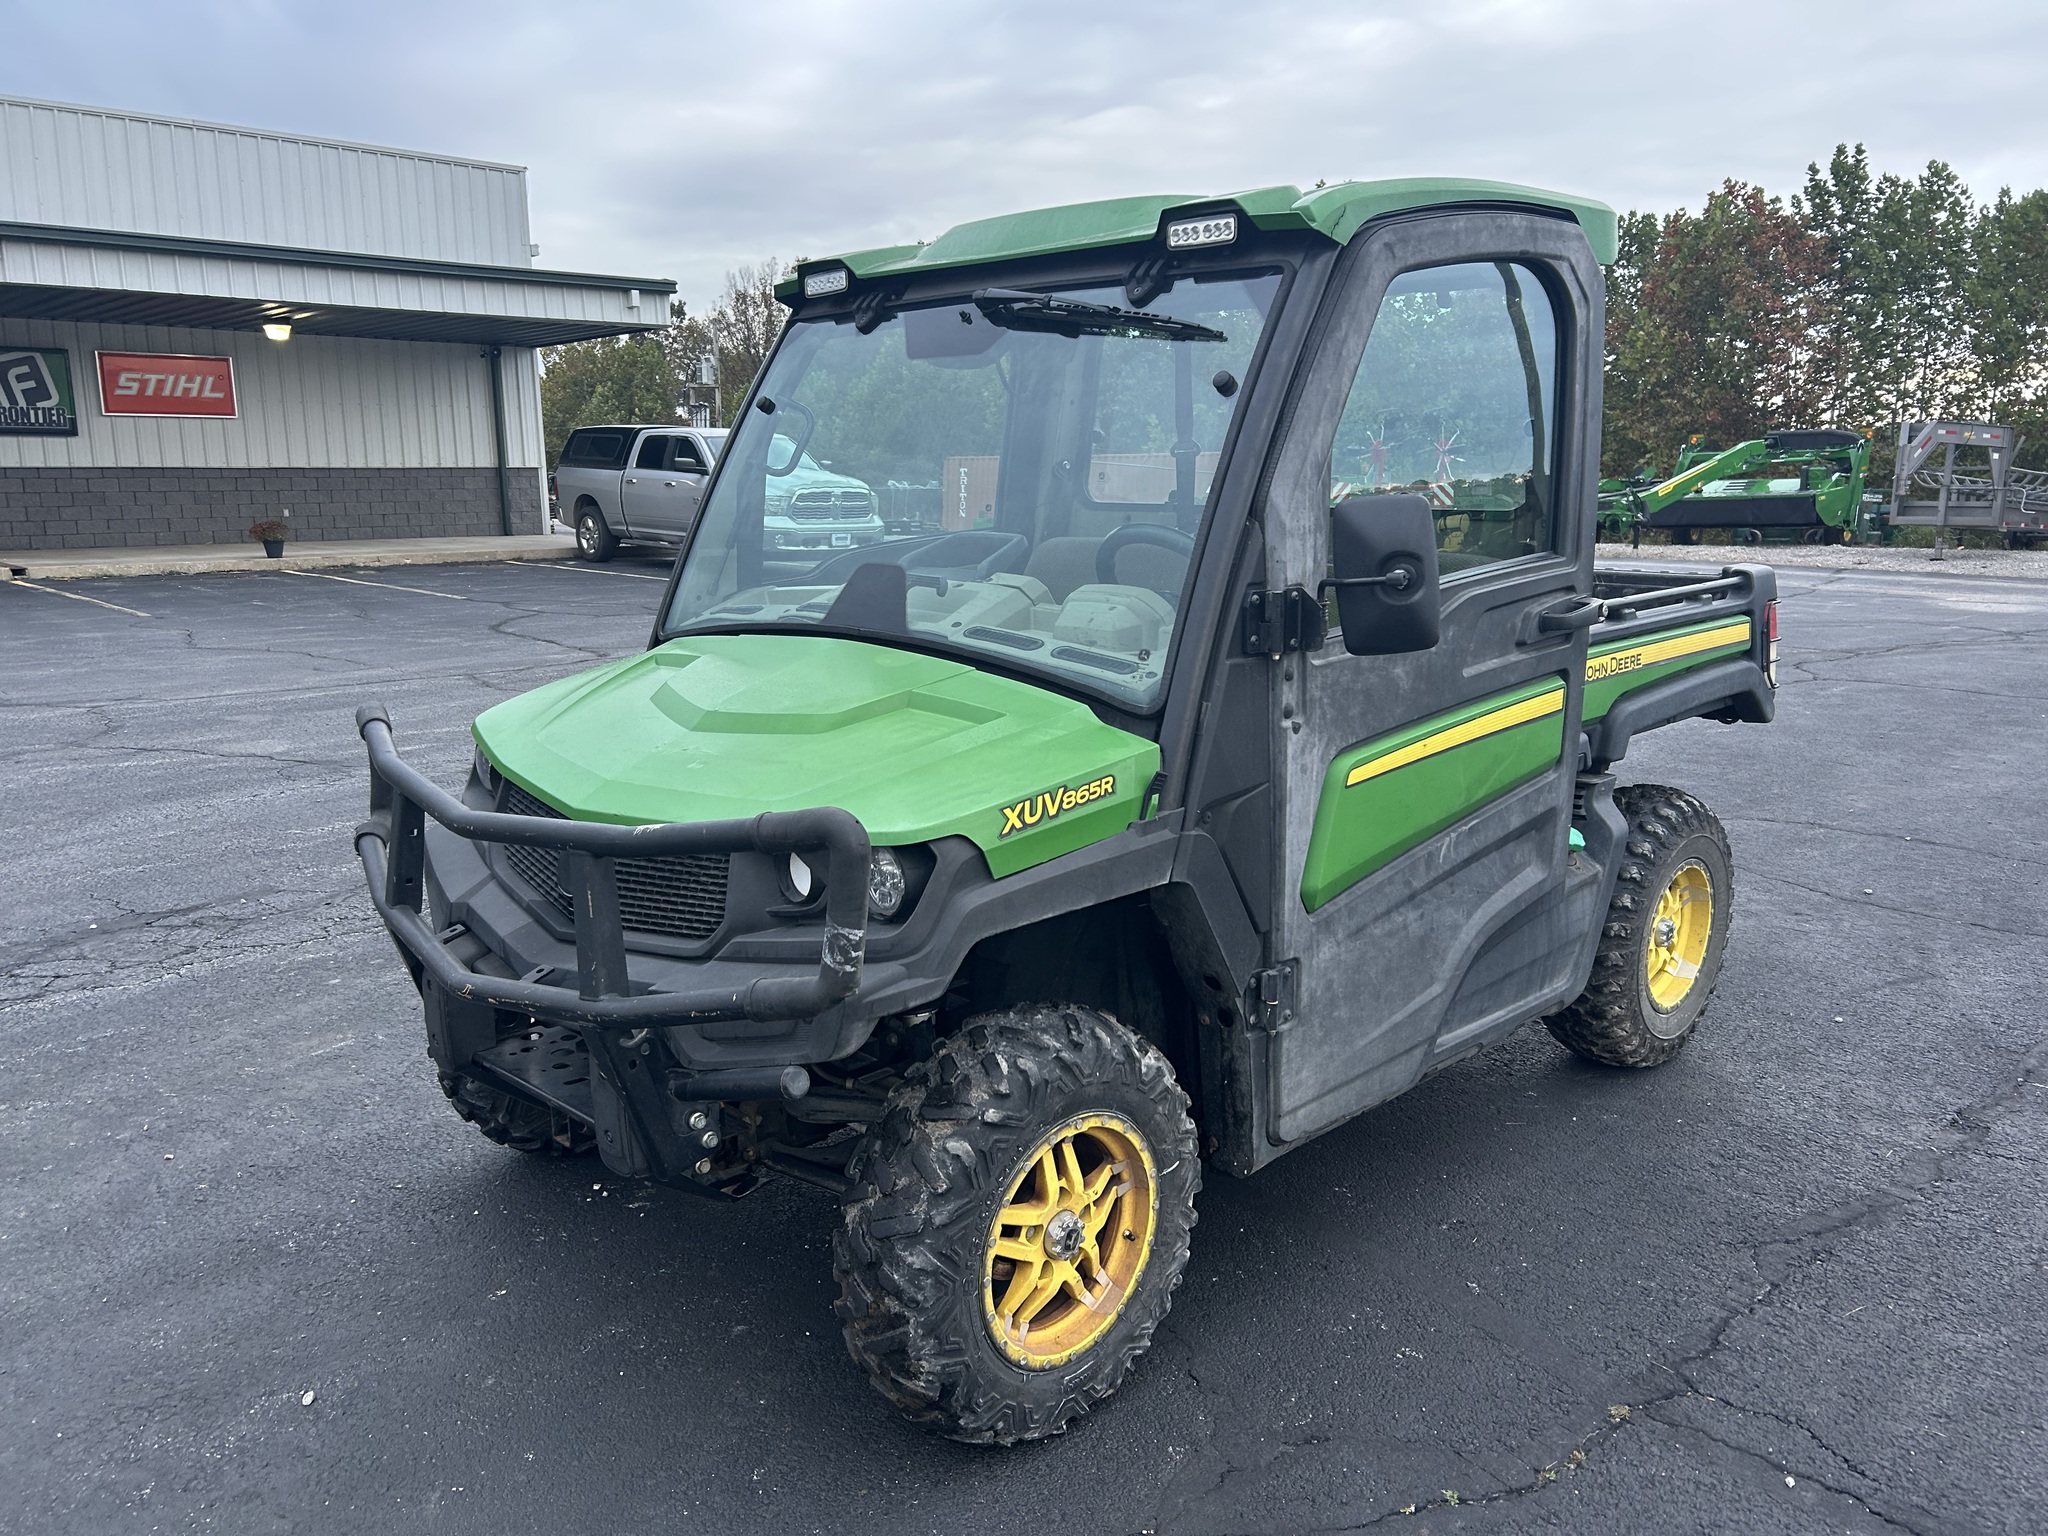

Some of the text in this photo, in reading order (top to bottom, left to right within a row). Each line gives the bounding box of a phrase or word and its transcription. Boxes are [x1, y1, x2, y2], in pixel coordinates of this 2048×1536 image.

[113, 371, 225, 398] STIHL
[0, 406, 67, 424] RONTIER
[959, 467, 968, 518] TRITON
[1586, 661, 1608, 679] OHN
[999, 775, 1115, 838] XUV865R
